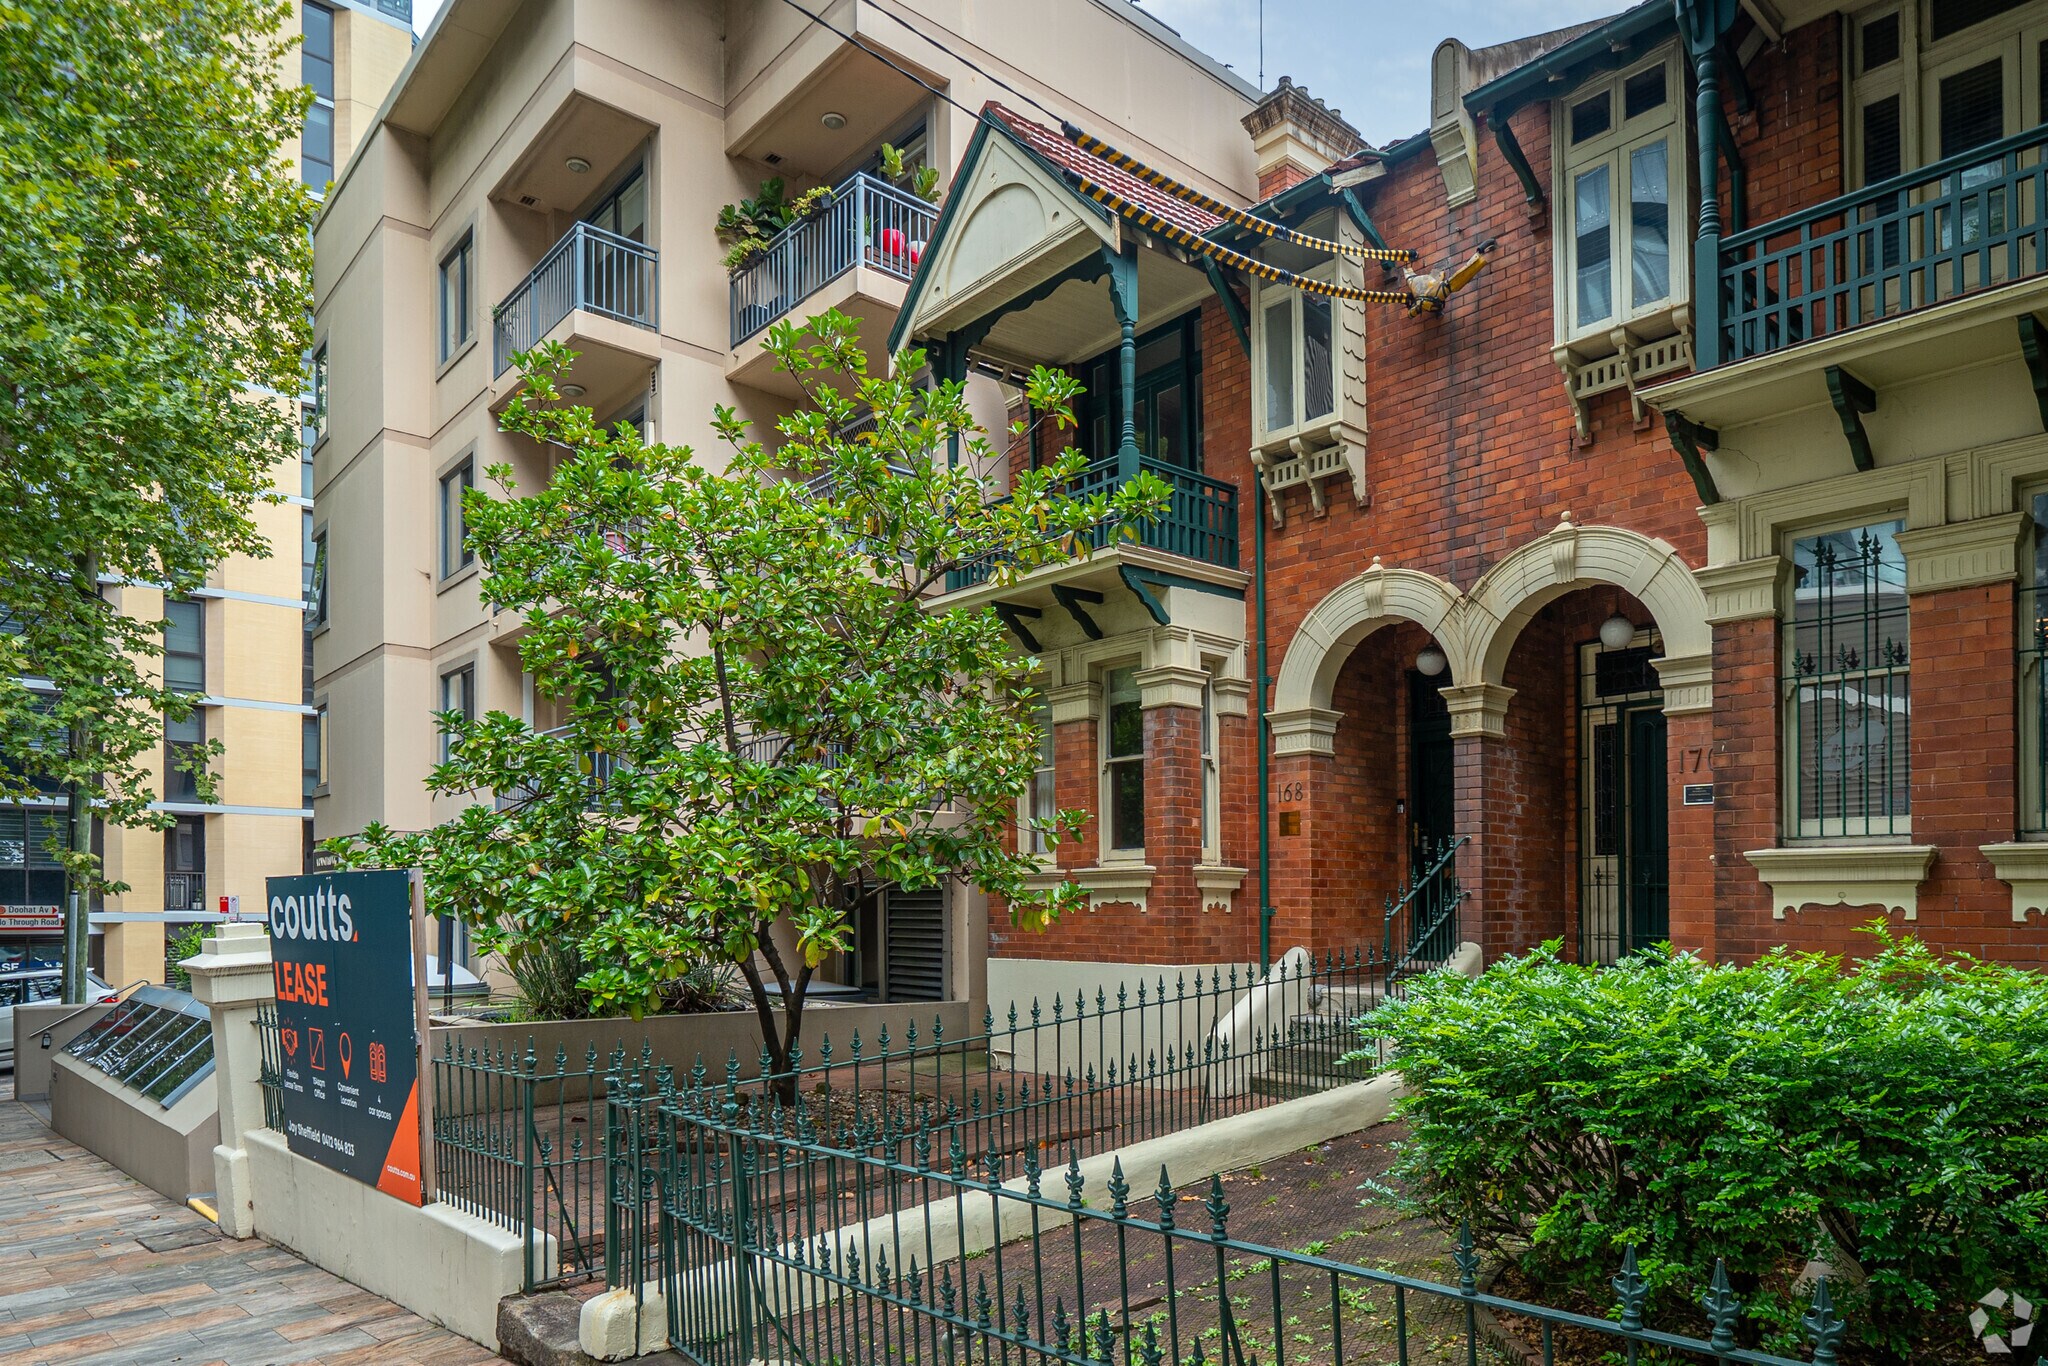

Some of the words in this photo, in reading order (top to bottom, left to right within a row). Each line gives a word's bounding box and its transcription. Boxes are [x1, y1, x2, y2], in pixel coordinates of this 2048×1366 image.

[1278, 782, 1303, 802] 168
[8, 905, 36, 914] Doohat
[38, 906, 49, 914] Av
[9, 918, 39, 927] Through
[40, 918, 59, 926] Road
[274, 961, 329, 1007] LEASE
[313, 1088, 326, 1100] Office
[337, 1081, 360, 1096] Convenient
[375, 1108, 392, 1121] spaces
[297, 1123, 321, 1144] Sheffield
[321, 1132, 334, 1149] 0412
[333, 1137, 344, 1153] 964
[344, 1141, 355, 1157] 823
[386, 1164, 416, 1182] coutts.com.au
